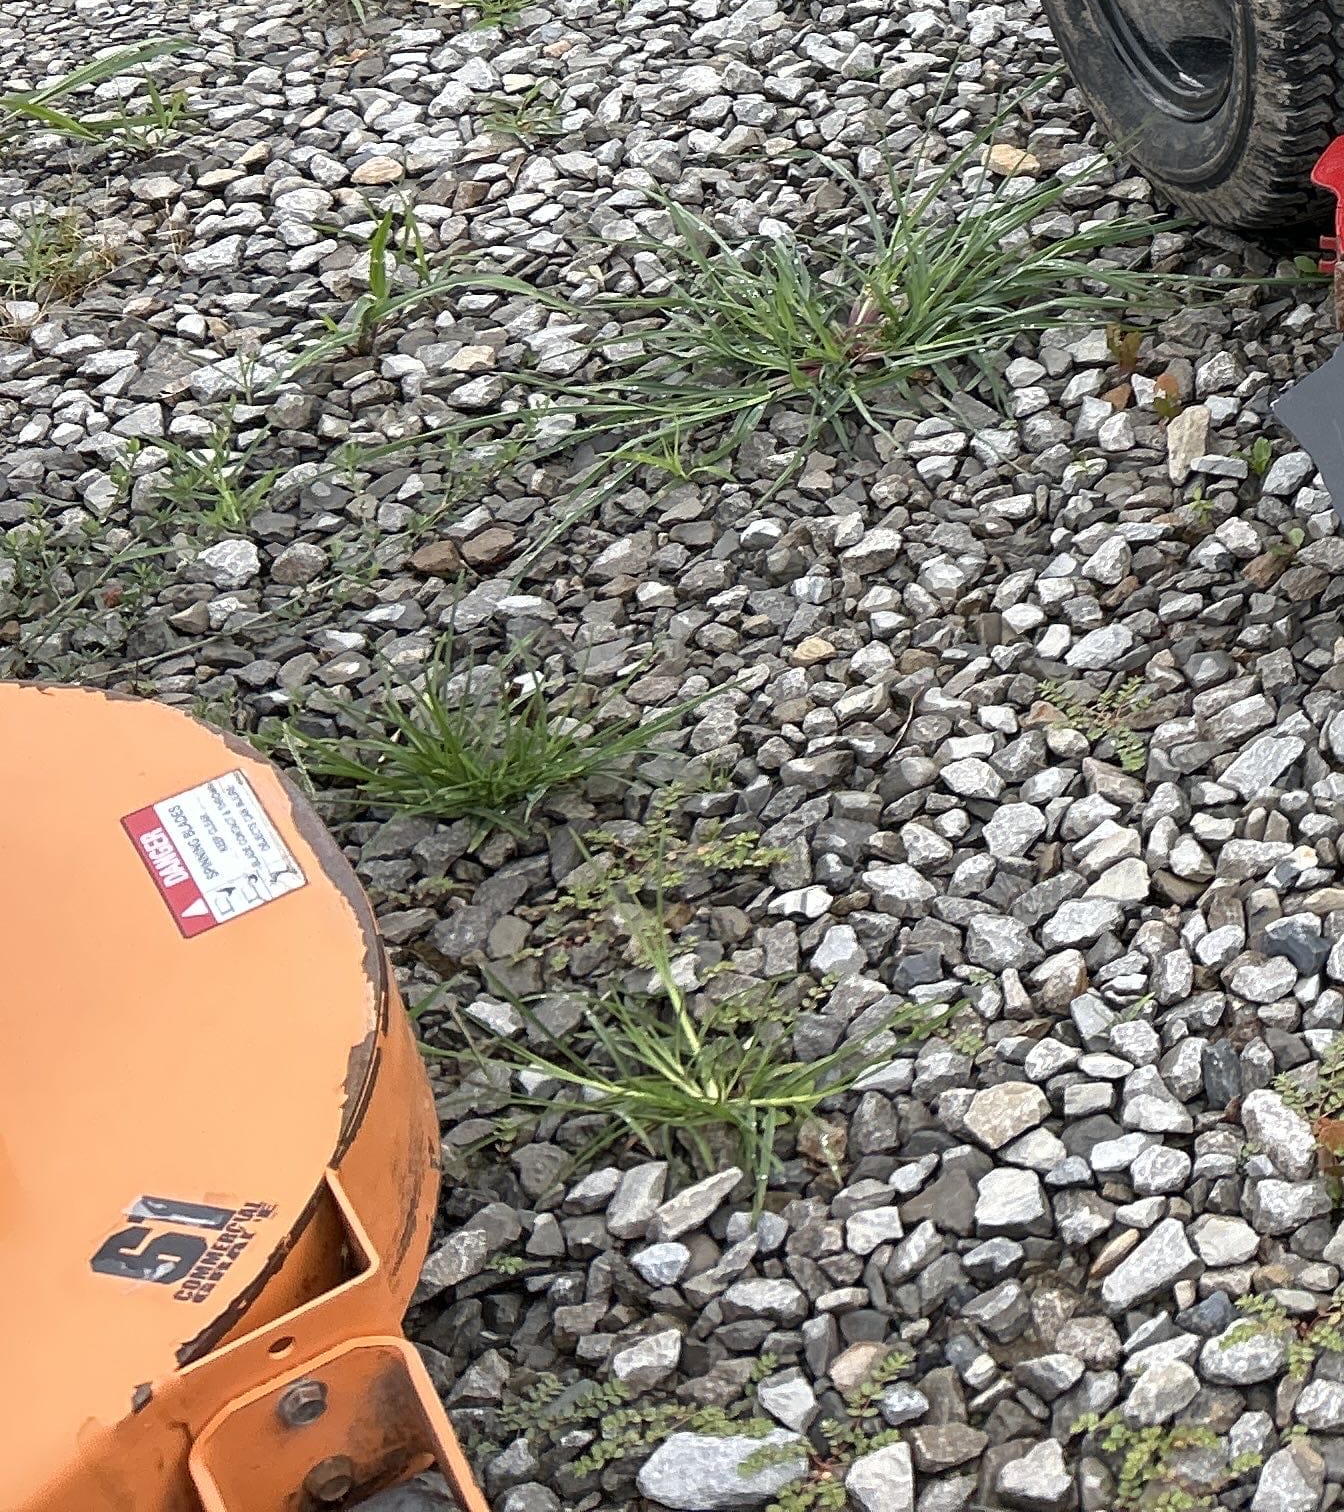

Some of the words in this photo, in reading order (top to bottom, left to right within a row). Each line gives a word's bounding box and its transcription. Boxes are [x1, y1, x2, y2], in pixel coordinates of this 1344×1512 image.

[168, 804, 195, 839] BLADES
[139, 826, 190, 888] DANGER
[173, 1201, 266, 1301] COMMERCIAL
